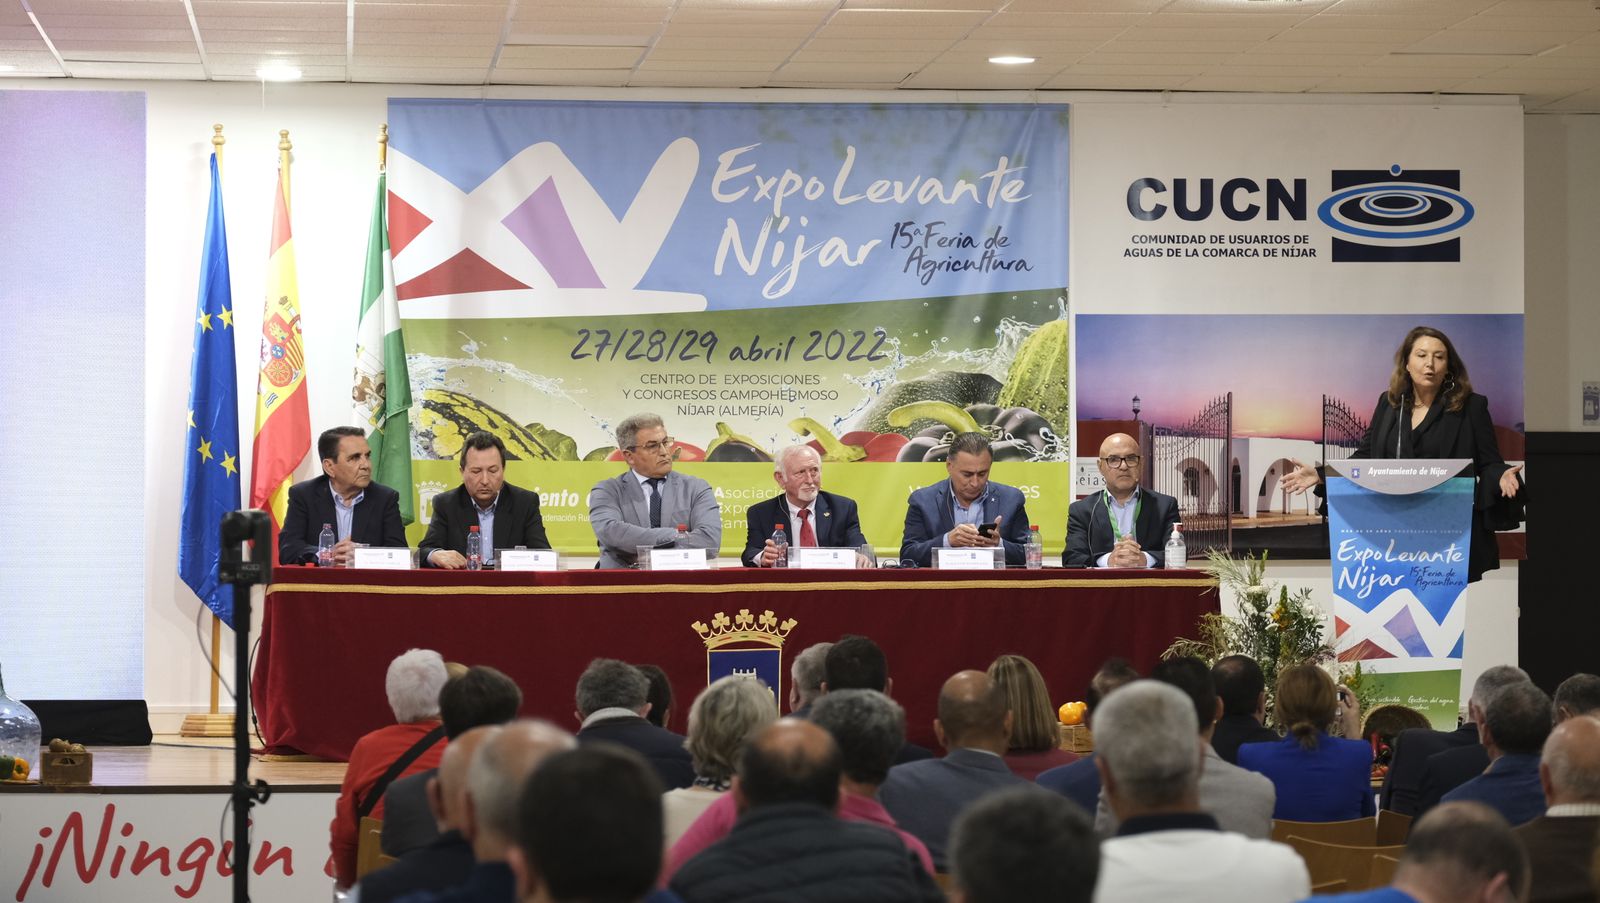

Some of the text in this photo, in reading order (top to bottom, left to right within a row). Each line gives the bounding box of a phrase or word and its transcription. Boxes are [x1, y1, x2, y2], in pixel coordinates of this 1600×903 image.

[1126, 177, 1307, 222] CUCN
[924, 221, 980, 248] Feria
[984, 225, 1011, 249] de
[1131, 234, 1309, 245] COMUNIDAD DE USUARIOS DE
[713, 215, 882, 299] Níjar
[1123, 245, 1317, 259] AGUAS DE LA COMARCA DE NÍJAR
[903, 246, 1034, 286] Agricultura
[570, 328, 887, 363] 27/28/29 abril 2022
[640, 374, 821, 385] CENTRO DE EXPOSICIONES
[622, 389, 839, 401] Y CONGRESOS CAMPOHERMOSO
[677, 403, 785, 418] NÍJAR (ALMERÍA)
[1368, 467, 1417, 477] Ayuntamiento
[1419, 467, 1428, 475] de
